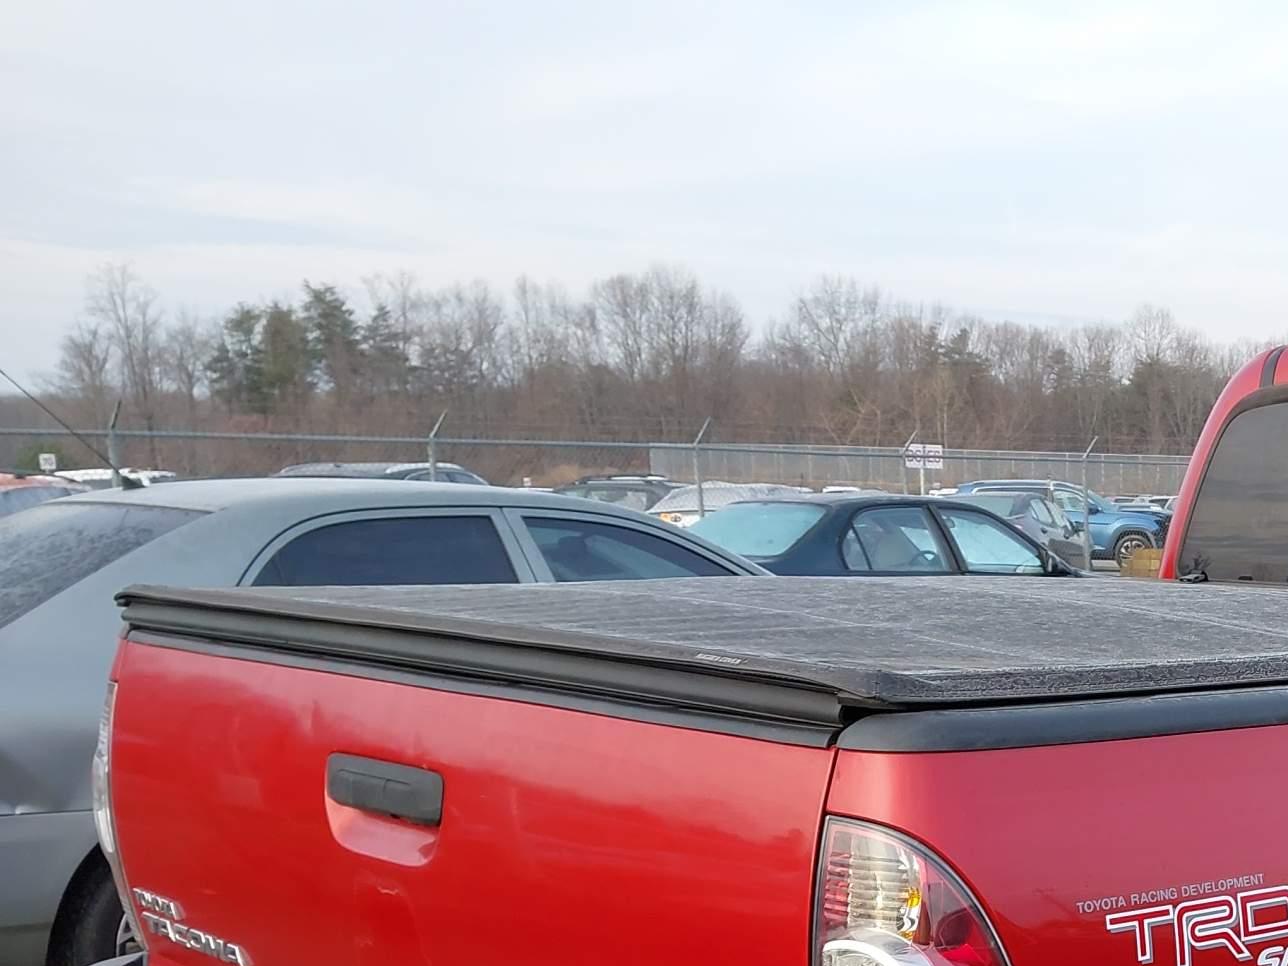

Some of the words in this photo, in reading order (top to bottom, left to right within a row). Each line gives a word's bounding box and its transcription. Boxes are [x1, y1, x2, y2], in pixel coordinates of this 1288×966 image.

[1076, 897, 1127, 914] TOYOTA
[1130, 886, 1179, 906] RACING
[1181, 873, 1265, 898] DEVELOPMENT
